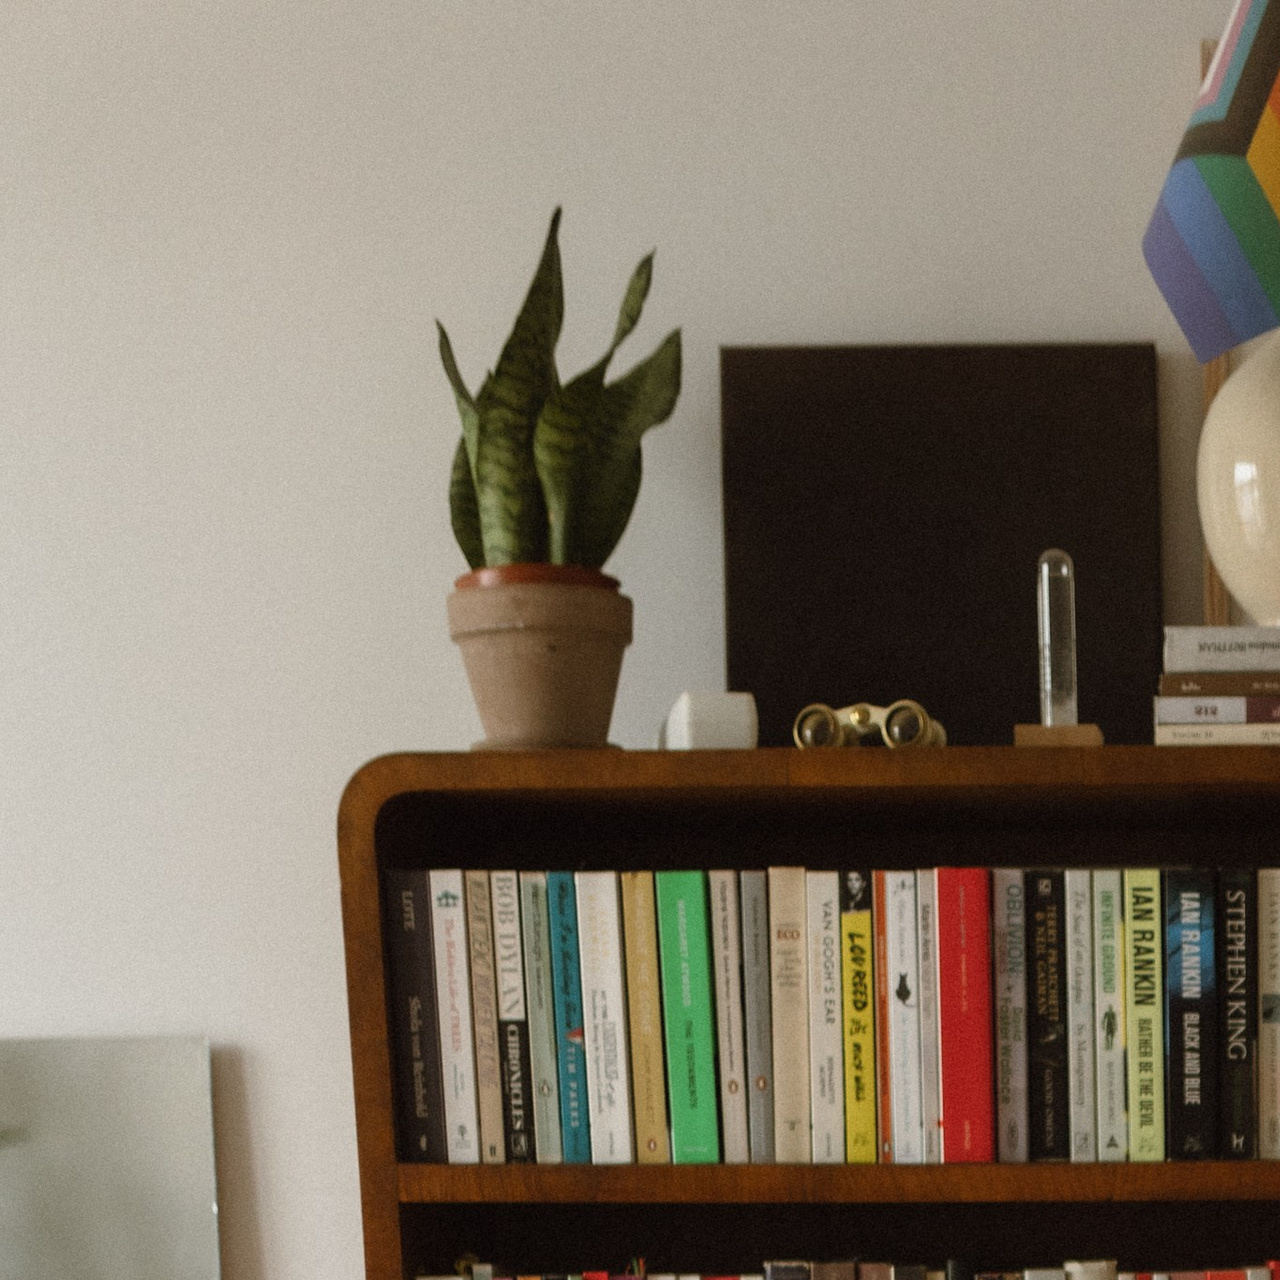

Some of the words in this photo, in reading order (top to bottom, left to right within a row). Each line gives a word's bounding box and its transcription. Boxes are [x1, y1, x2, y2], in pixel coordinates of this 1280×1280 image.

[402, 890, 415, 931] LOTE
[495, 876, 517, 925] BOB
[822, 901, 834, 931] VAN
[1100, 890, 1114, 941] INFINITE
[1131, 886, 1154, 921] IAN
[1180, 891, 1201, 924] IAN
[676, 899, 689, 958] MARGARET
[1006, 884, 1023, 974] OBLIVION
[1035, 926, 1047, 956] NEIL
[1046, 904, 1058, 945] TERRY
[1226, 888, 1247, 995] STEPHEN
[823, 936, 835, 994] GOGH'S
[848, 932, 865, 967] LOU
[1102, 945, 1115, 994] GROUND
[1133, 929, 1156, 1007] RANKIN
[1181, 930, 1202, 999] RANKIN
[498, 933, 521, 1014] DYLAN
[680, 961, 691, 1007] ATWOOD
[853, 968, 867, 1012] REED
[1036, 960, 1049, 1015] GAIMAN
[1046, 949, 1059, 1022] PRATCHETT
[824, 999, 836, 1025] EAR
[1000, 997, 1012, 1041] Foster
[1011, 1006, 1023, 1042] David
[1183, 1011, 1200, 1049] BLACK
[1226, 1000, 1247, 1061] KING
[566, 1046, 576, 1073] TIM
[1138, 1018, 1153, 1058] RATHER
[507, 1024, 523, 1130] CHRONICLES
[1000, 1045, 1013, 1105] Wallace
[1138, 1061, 1153, 1074] BE
[1184, 1052, 1201, 1074] AND
[568, 1081, 580, 1128] PARKS
[1139, 1077, 1154, 1097] THE
[1184, 1077, 1201, 1105] BLUE
[1139, 1099, 1155, 1129] DEVIL
